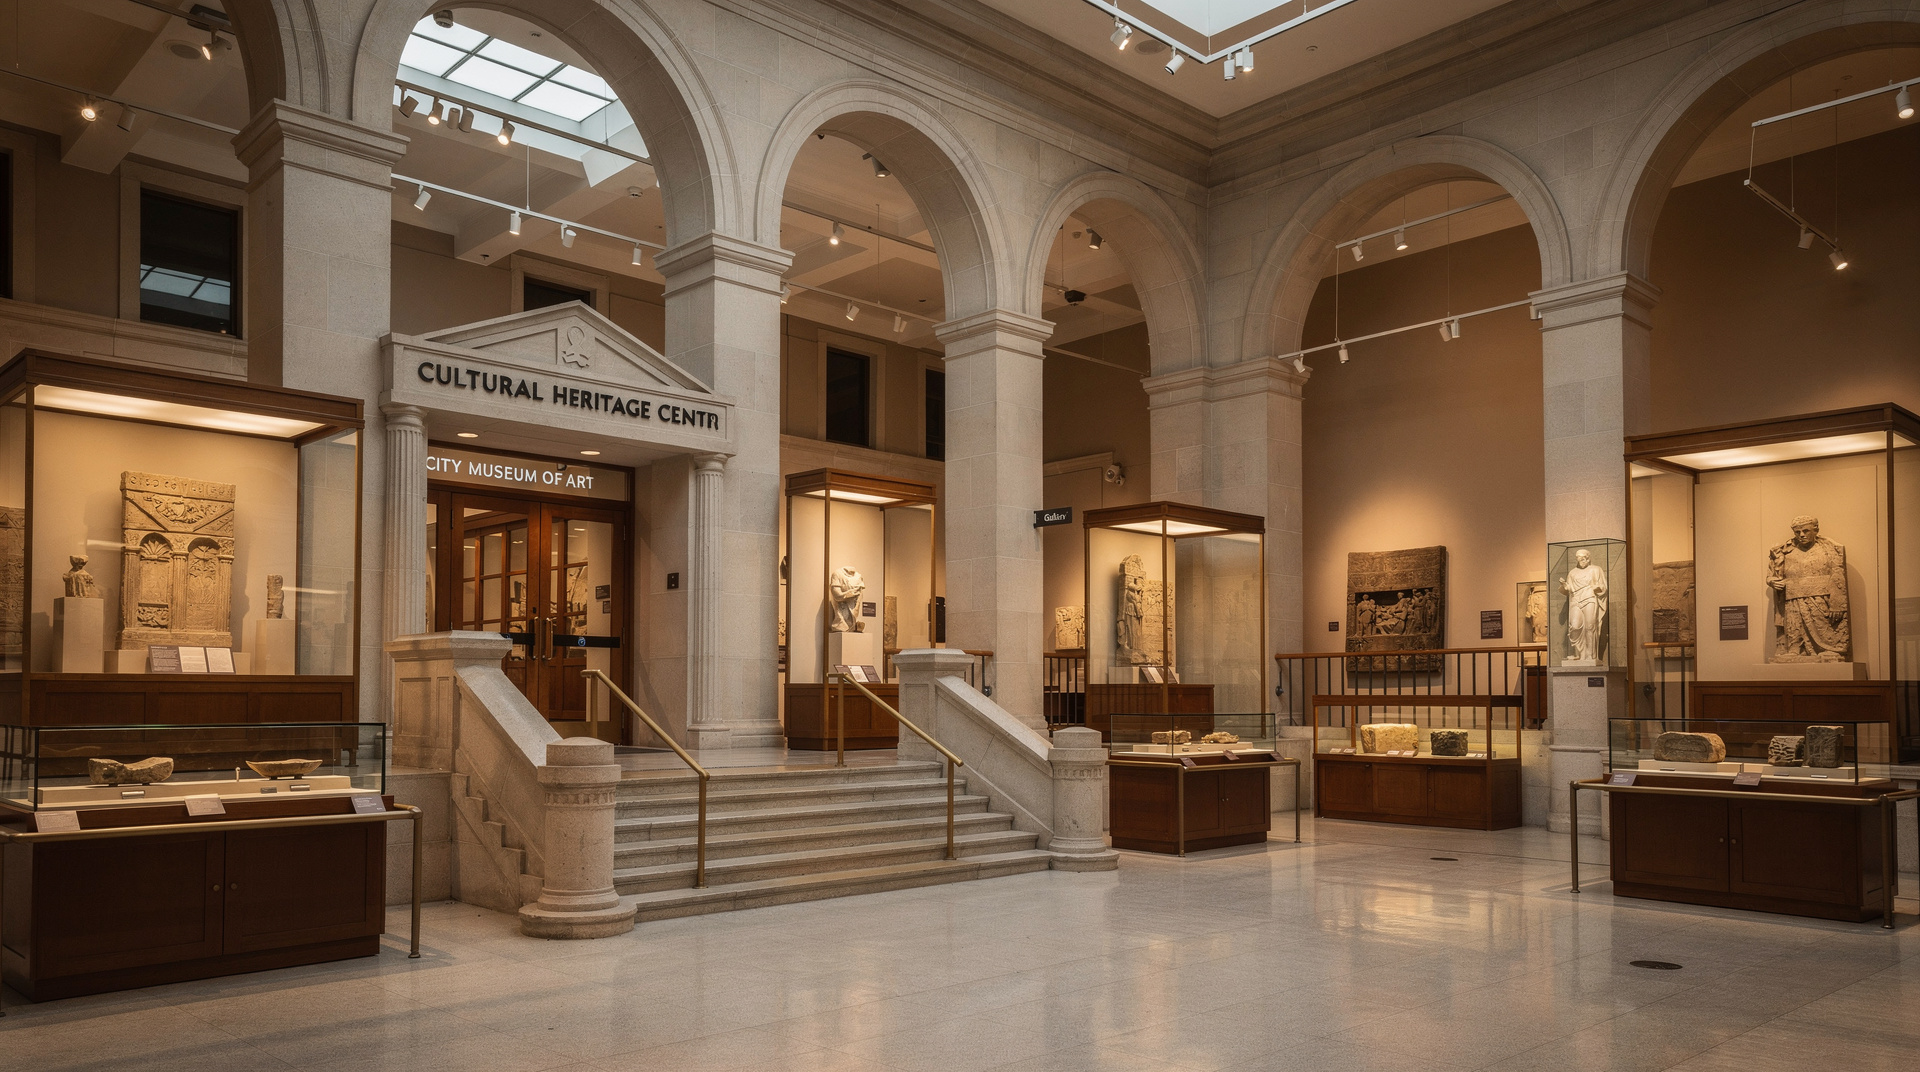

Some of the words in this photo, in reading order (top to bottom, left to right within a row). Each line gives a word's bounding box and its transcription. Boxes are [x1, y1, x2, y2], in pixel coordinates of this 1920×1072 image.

[418, 362, 544, 401] CULTURAL
[553, 385, 651, 420] HERITAGE
[426, 456, 462, 473] CITY
[468, 461, 537, 483] MUSEUM
[542, 471, 563, 486] OF
[565, 474, 594, 490] ART
